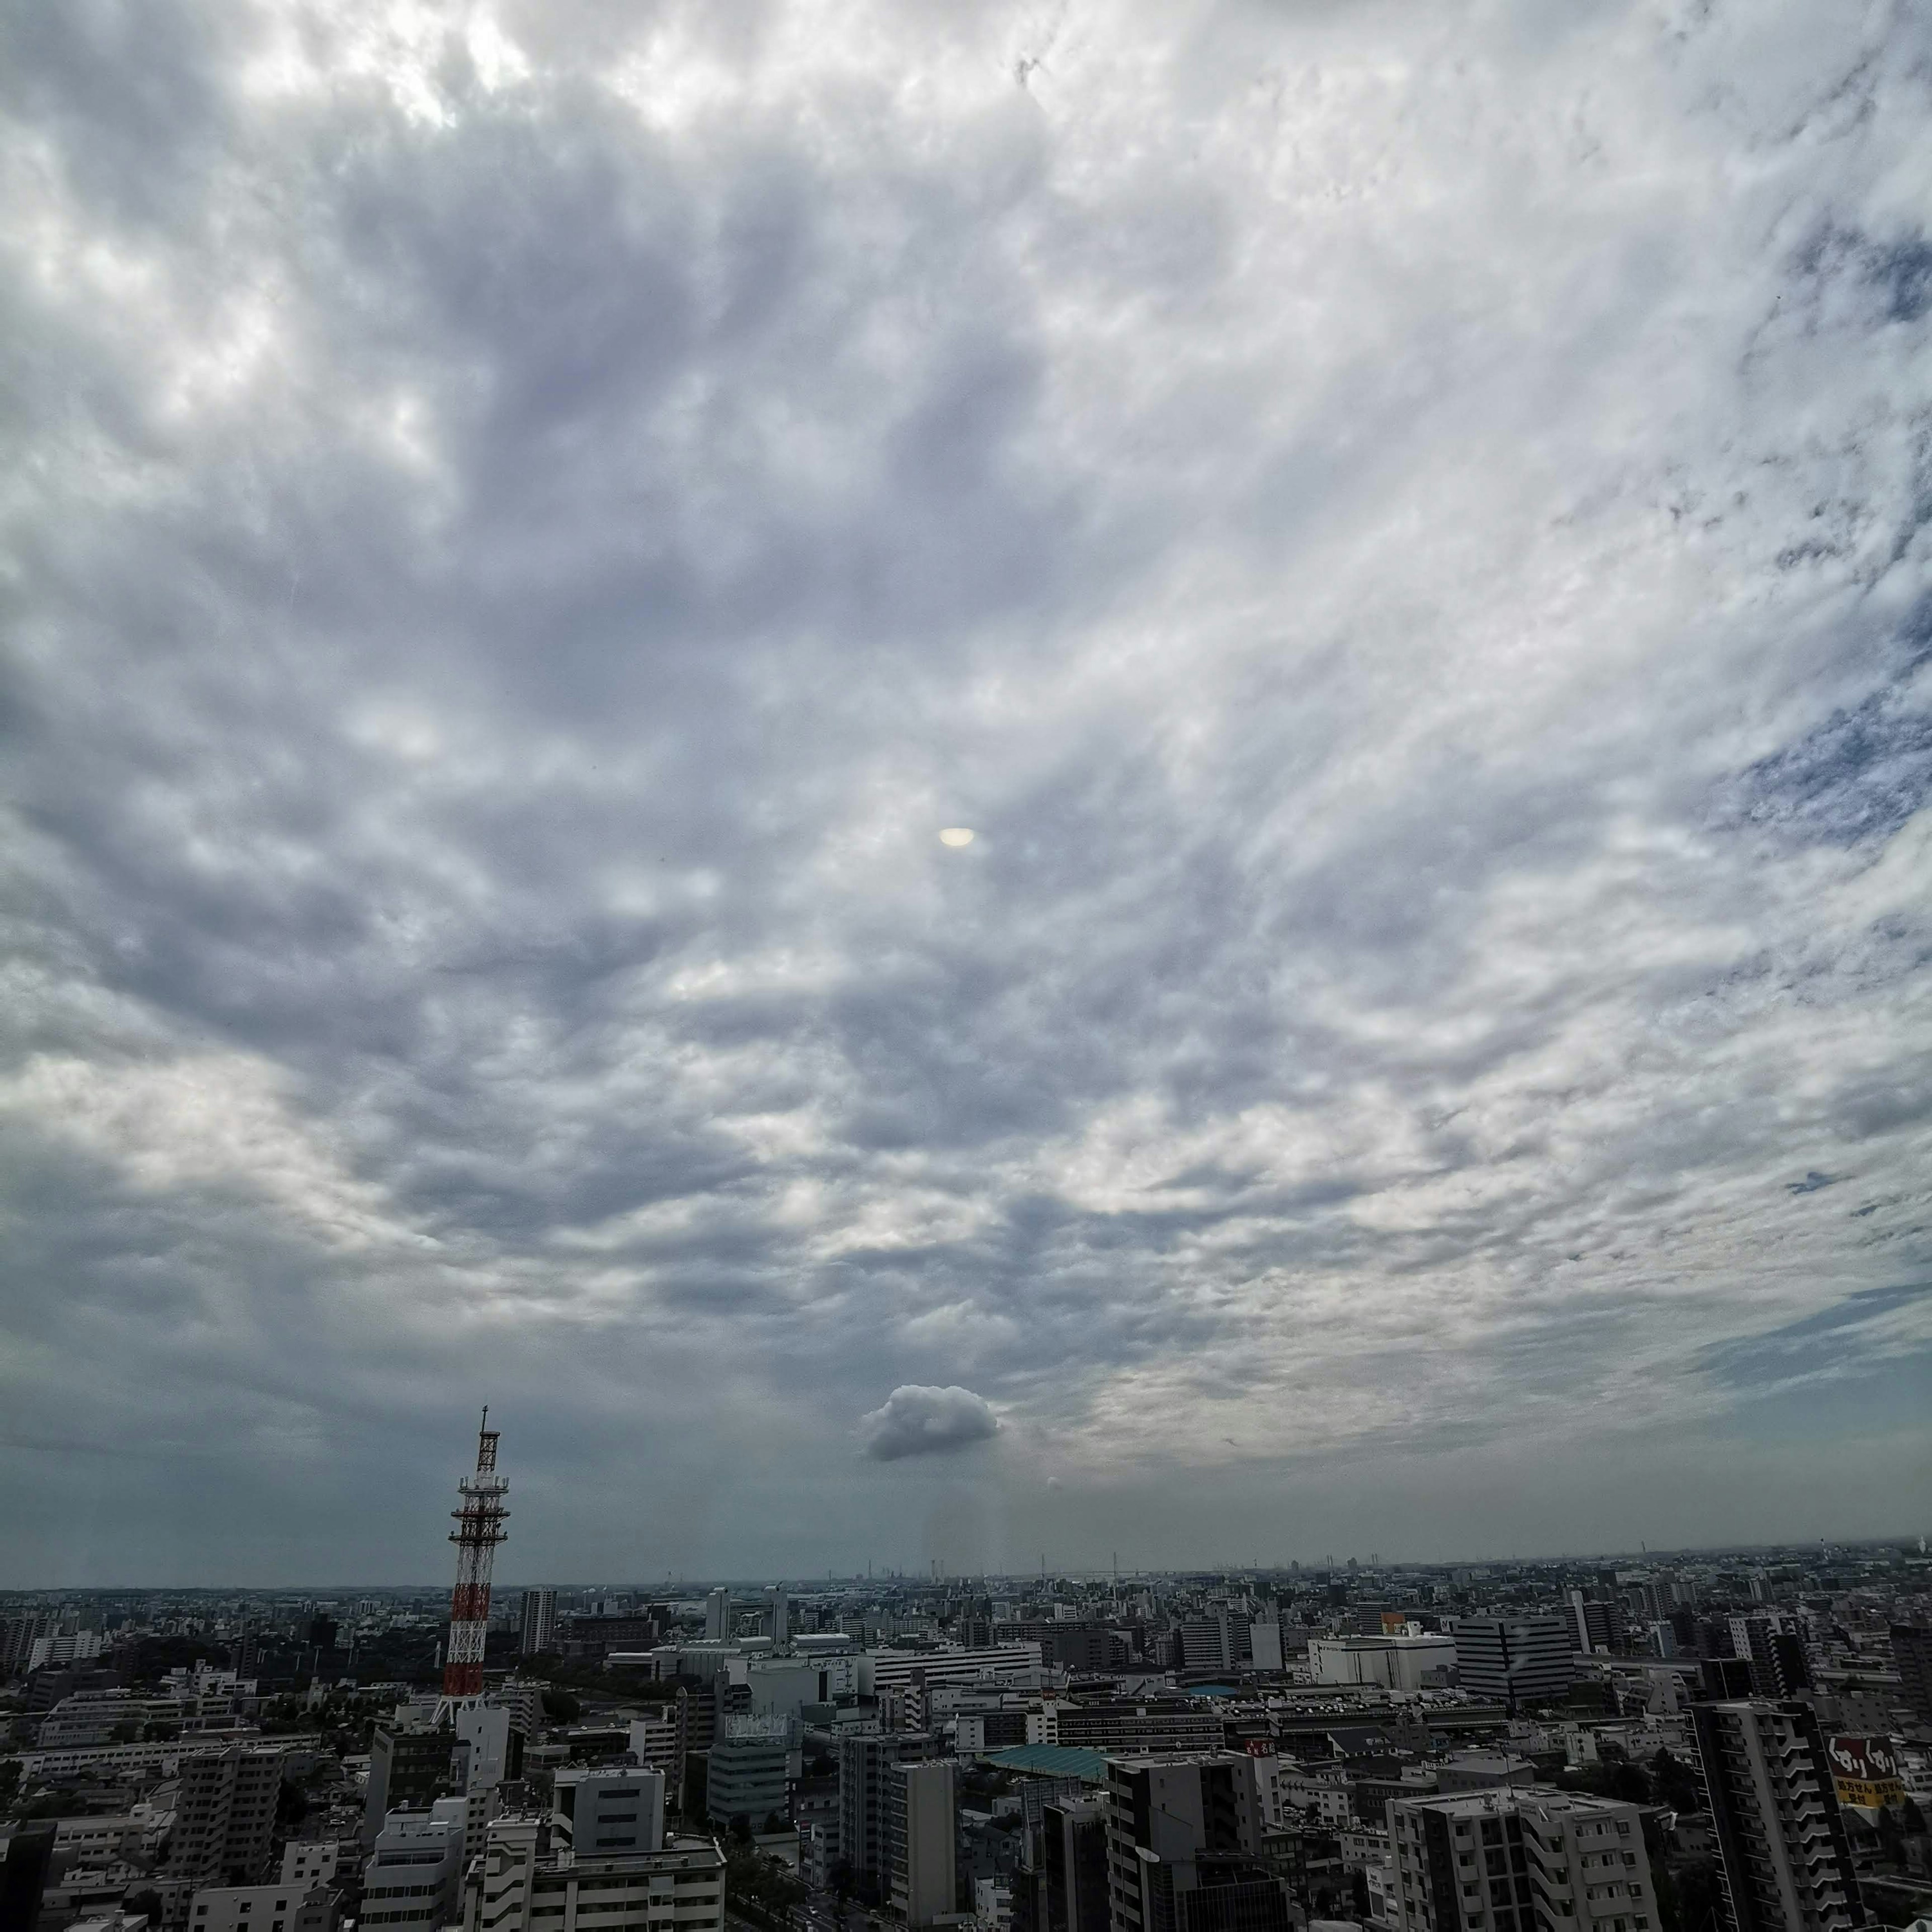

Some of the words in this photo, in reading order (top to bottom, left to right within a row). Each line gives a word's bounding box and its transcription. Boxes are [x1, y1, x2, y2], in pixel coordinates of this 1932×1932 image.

[1828, 1737, 1867, 1779] くすり
[1865, 1739, 1897, 1776] くすり
[1837, 1780, 1872, 1794] 処方せん
